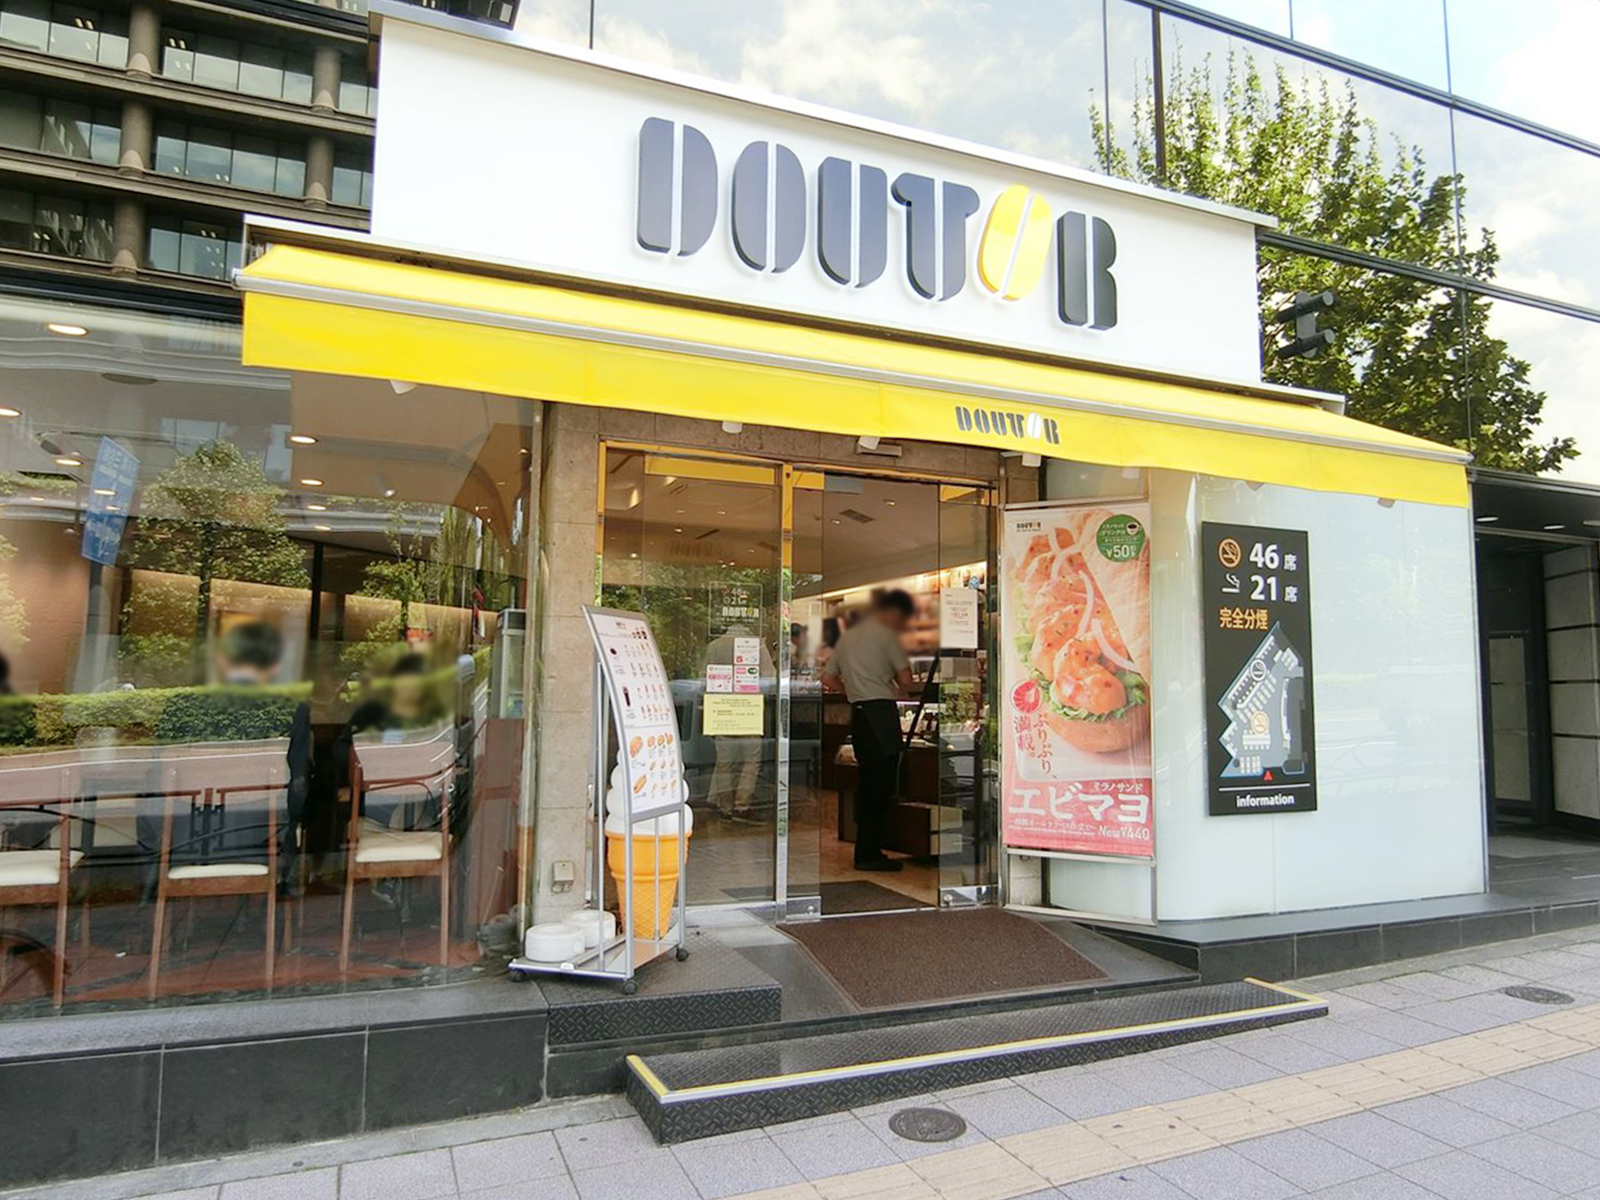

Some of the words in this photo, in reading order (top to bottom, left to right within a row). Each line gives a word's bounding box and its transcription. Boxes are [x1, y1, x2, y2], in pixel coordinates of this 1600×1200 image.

[637, 116, 1117, 331] DOUTOR
[955, 406, 1060, 444] DOUTOR
[1249, 543, 1280, 569] 46
[1284, 554, 1297, 571] 席
[1250, 575, 1277, 601] 21
[1284, 586, 1298, 602] 席
[1220, 607, 1268, 630] 完全分煙
[1093, 781, 1143, 793] ミラノサンド
[1236, 793, 1295, 808] information
[1009, 782, 1149, 824] エビマヨ
